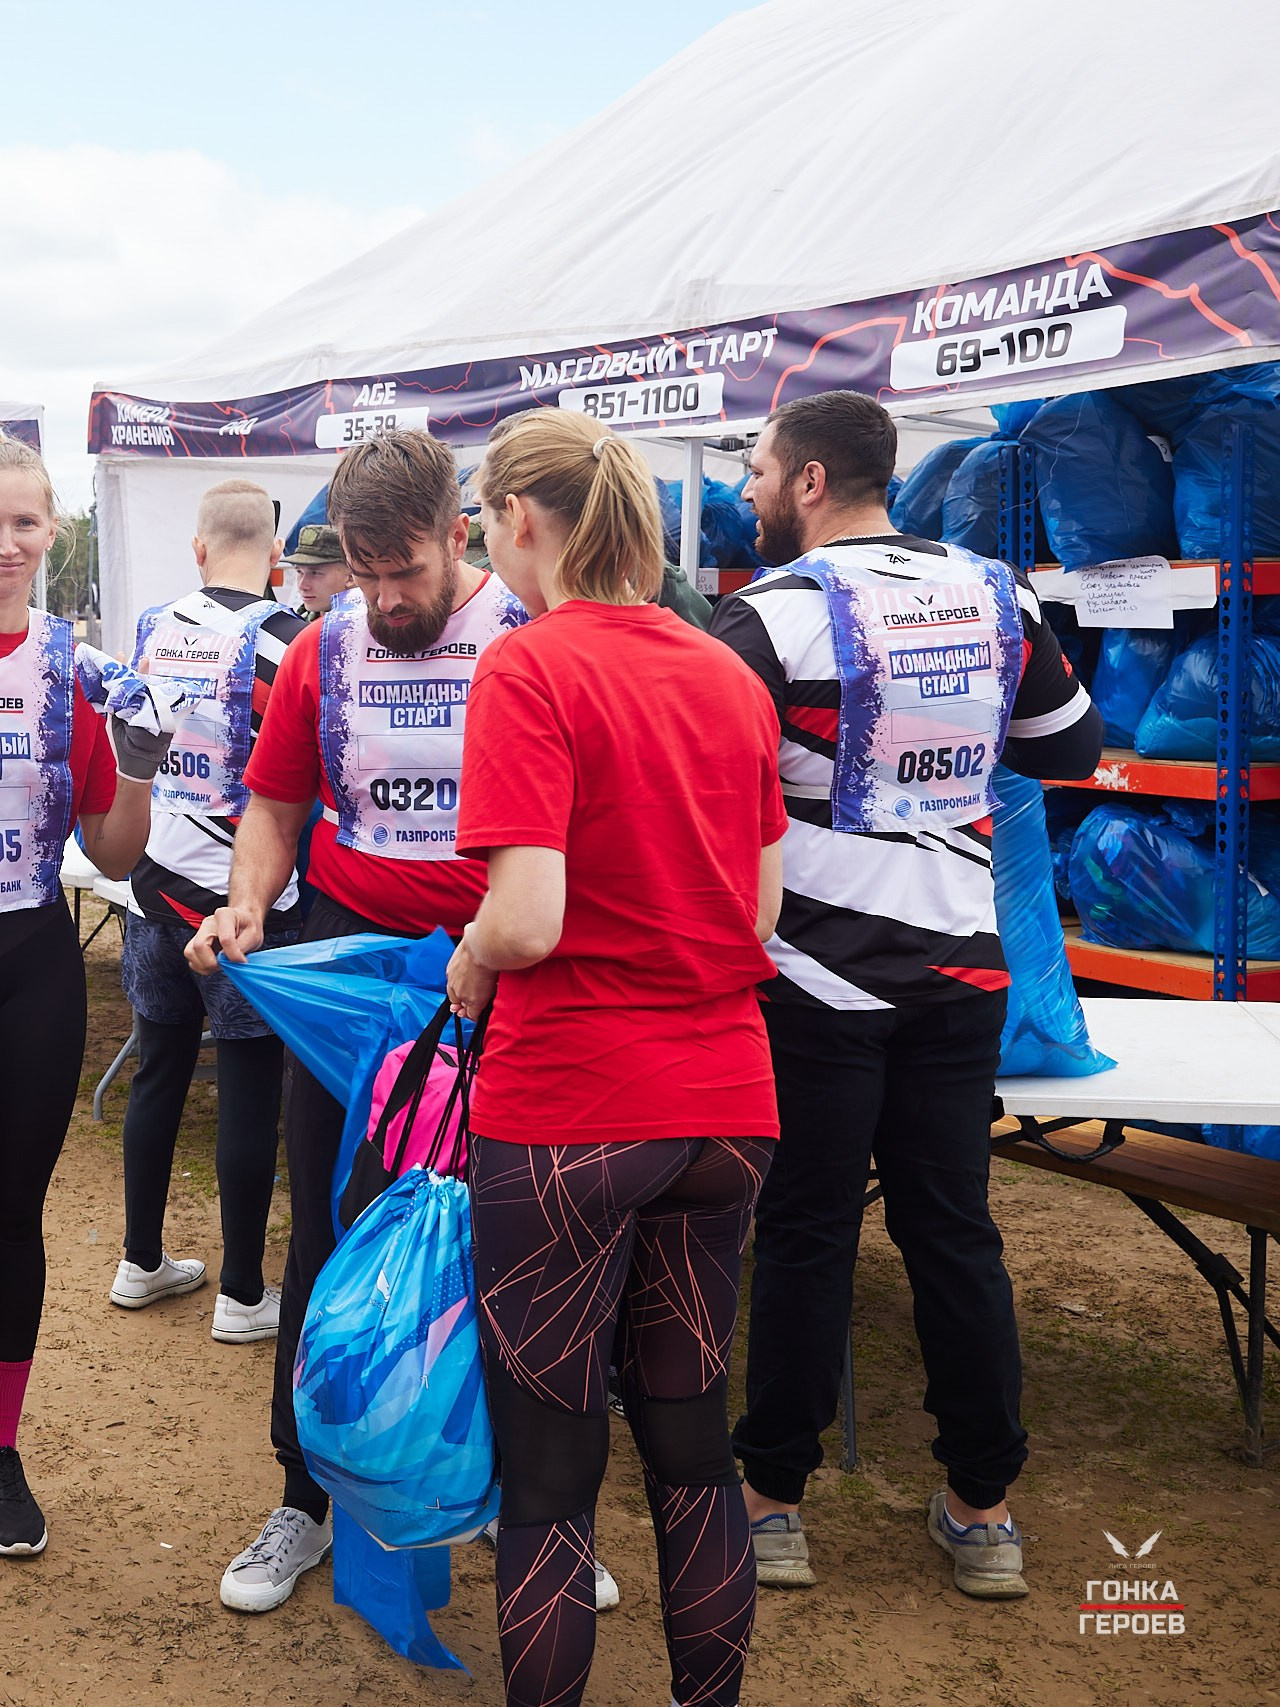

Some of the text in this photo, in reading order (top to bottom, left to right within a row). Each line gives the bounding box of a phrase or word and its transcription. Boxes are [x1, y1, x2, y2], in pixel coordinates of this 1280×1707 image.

[912, 263, 1113, 334] КОМАНДА
[519, 327, 779, 391] МАССОВЫЙ СТАРТ
[935, 322, 1073, 377] 69-100
[353, 382, 397, 407] AGE
[583, 382, 700, 419] 851-1100
[116, 404, 171, 423] КАМЕРА
[111, 425, 175, 446] ХРАНЕНИЯ
[219, 417, 259, 436] PRO
[883, 606, 980, 626] ГОНКА ГЕРОЕВ
[155, 648, 220, 660] ГОНКА ГЕРОЕВ
[421, 643, 477, 659] ГЕРОЕВ
[891, 641, 990, 674] КОМАНДНЫЙ
[361, 683, 470, 706] КОМАНДНЫ
[921, 673, 966, 696] СТАРТ
[393, 706, 447, 726] СТАРТ
[157, 751, 210, 779] 8506
[897, 743, 986, 784] 08502
[370, 778, 457, 811] 0320
[920, 793, 981, 813] ГАЗПРОМБАНК
[396, 830, 456, 843] ГАЗПРОМБ
